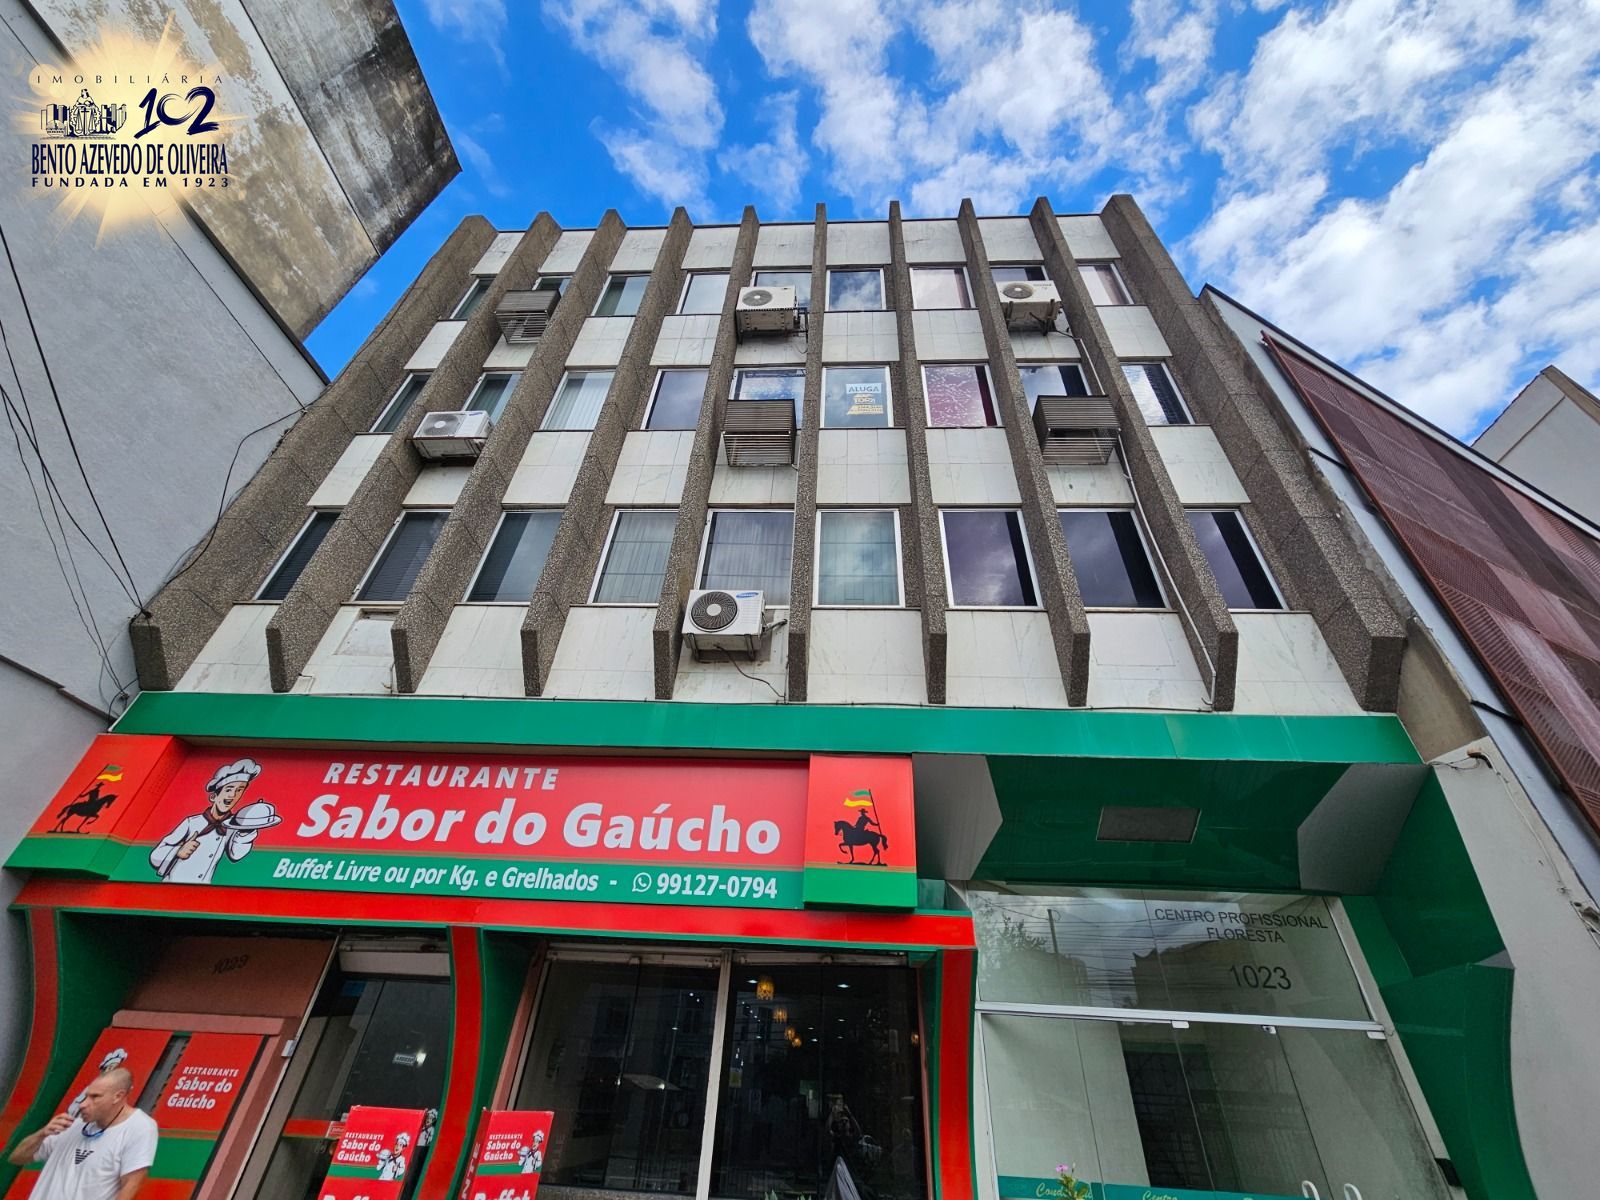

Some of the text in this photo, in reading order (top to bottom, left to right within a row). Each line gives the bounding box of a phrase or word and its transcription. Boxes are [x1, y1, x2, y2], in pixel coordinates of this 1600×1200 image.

[323, 762, 559, 790] RESTAURANTE
[297, 794, 781, 854] Sabor do Gaúcho
[272, 857, 333, 880] Buffet
[333, 860, 381, 882] Livre
[384, 866, 408, 883] ou
[410, 867, 447, 888] por
[449, 864, 479, 891] Kg.
[485, 869, 498, 887] e
[501, 867, 599, 891] Grelhados
[656, 873, 777, 899] 99127-0794
[1154, 909, 1328, 929] CENTRO PROFISSIONAL
[1206, 927, 1286, 943] FLORESTA
[1230, 964, 1292, 990] 1023
[183, 1066, 240, 1077] RESTAURANTE
[175, 1076, 233, 1093] Sabor do
[167, 1093, 216, 1109] Gaúcho
[345, 1132, 384, 1140] RESTAURANTE
[341, 1139, 380, 1151] Sabor do
[486, 1140, 521, 1150] Sabor do
[337, 1151, 371, 1162] Gaúcho
[484, 1151, 513, 1160] Gaúcho
